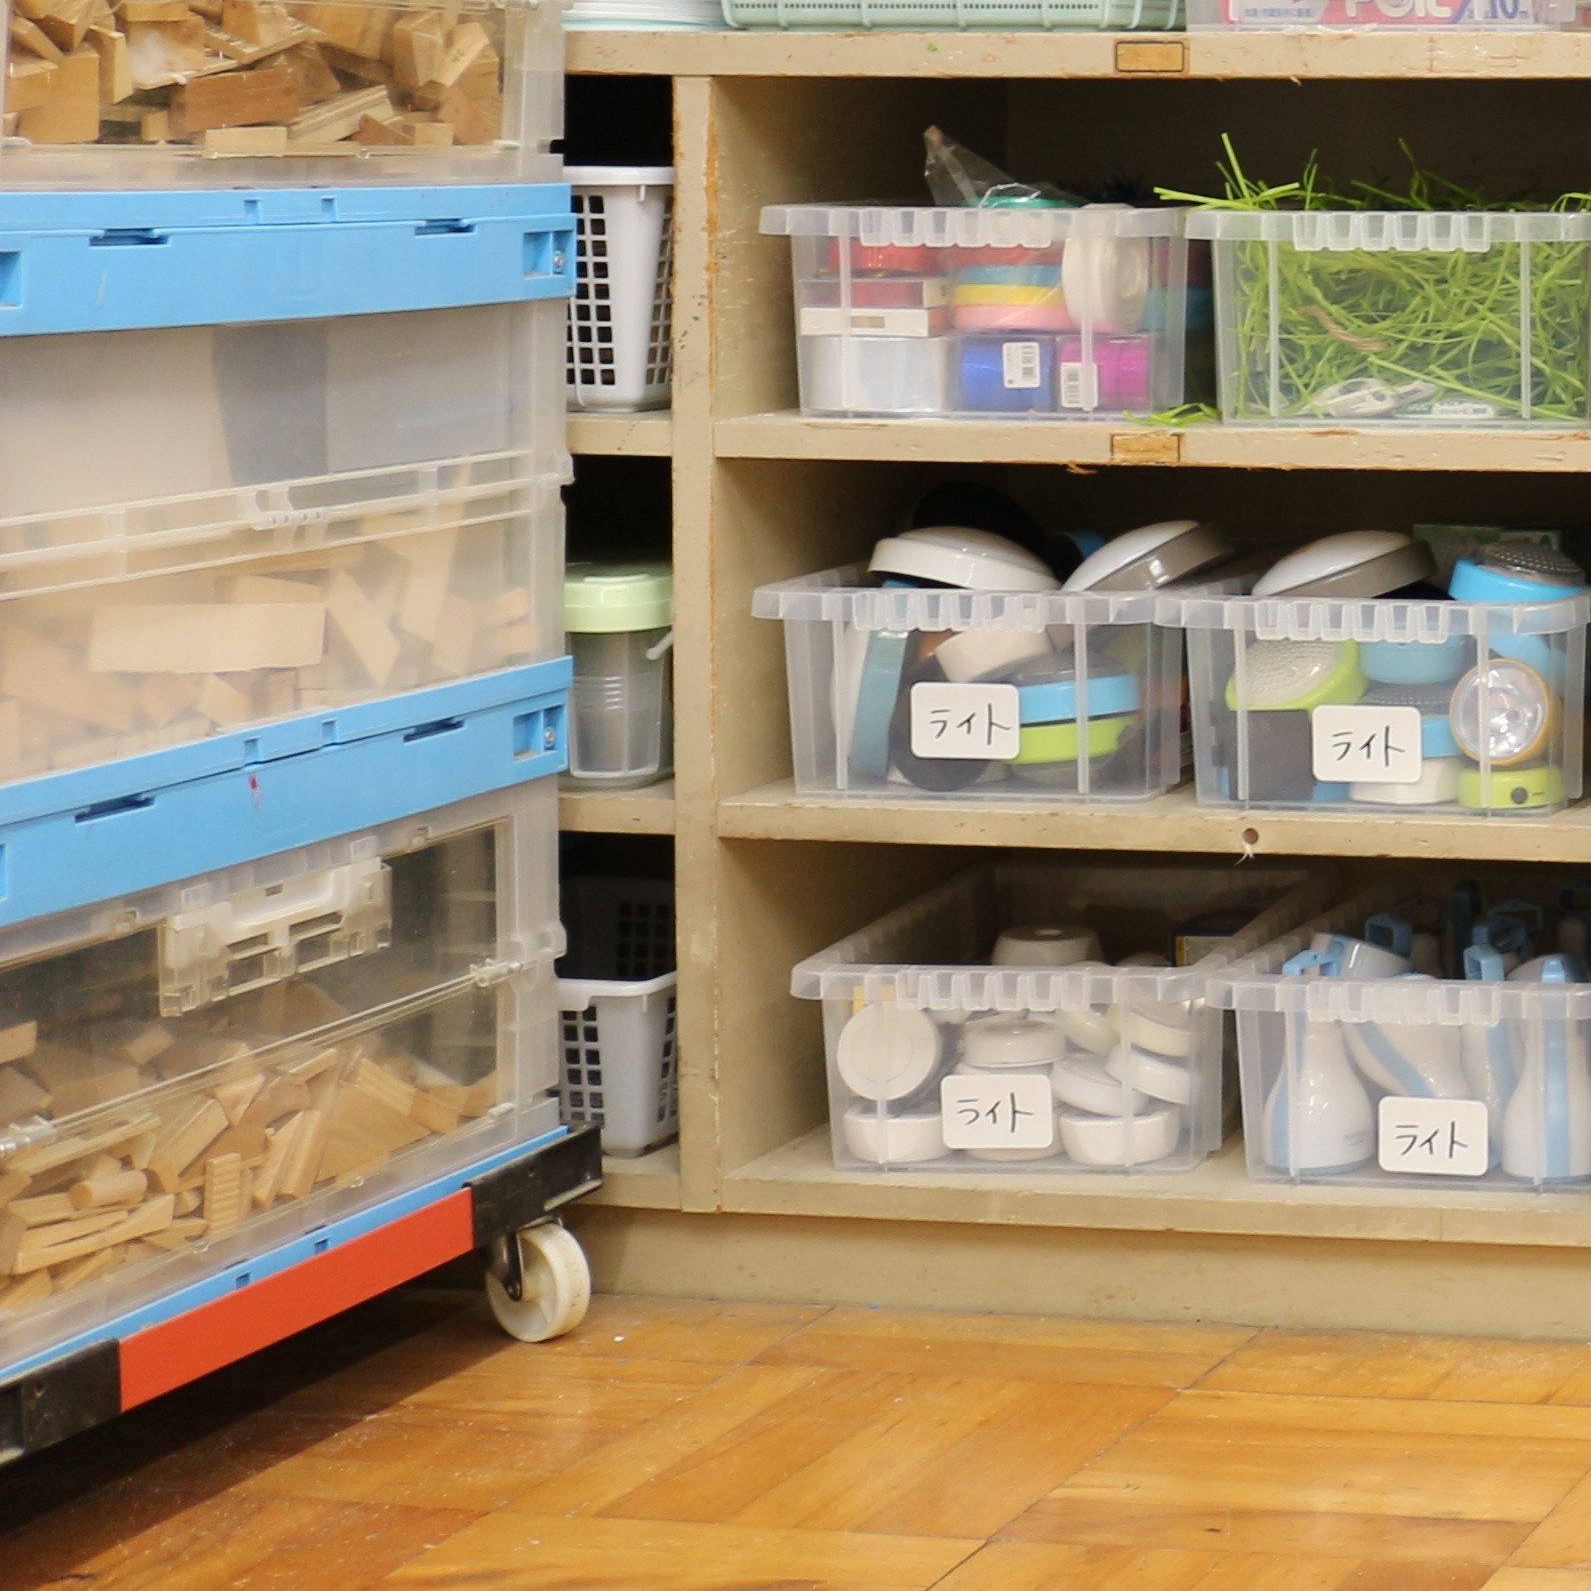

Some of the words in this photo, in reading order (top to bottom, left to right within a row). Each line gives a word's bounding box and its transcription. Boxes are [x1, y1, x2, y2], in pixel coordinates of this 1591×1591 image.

[929, 702, 1012, 747] ライト
[1330, 723, 1406, 768] ライト
[956, 1091, 1035, 1135] ライト
[1394, 1120, 1470, 1161] ライト
